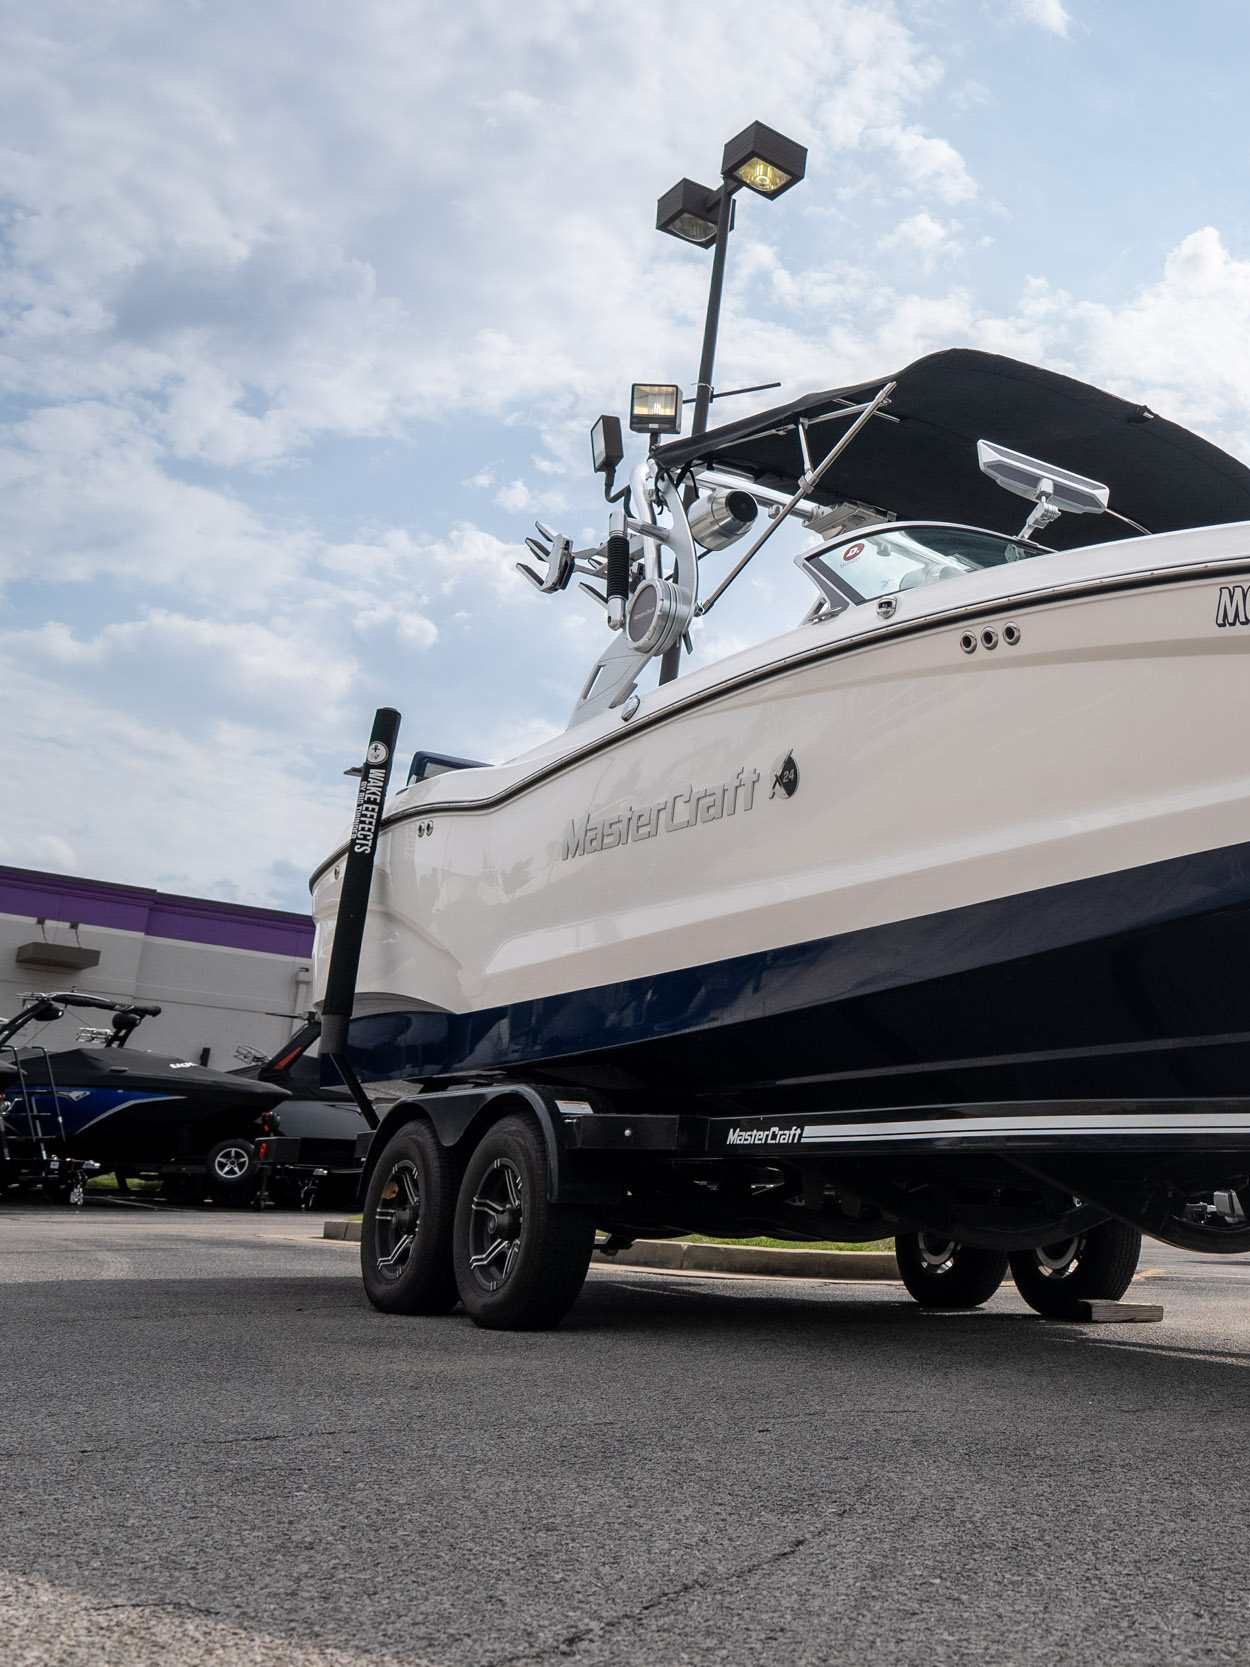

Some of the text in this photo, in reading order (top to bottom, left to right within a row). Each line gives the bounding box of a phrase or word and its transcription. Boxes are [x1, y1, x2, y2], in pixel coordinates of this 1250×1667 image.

[354, 768, 386, 854] WAKE EFFECTS
[561, 767, 760, 861] MasterCraft
[726, 1126, 801, 1145] MasterCraft
